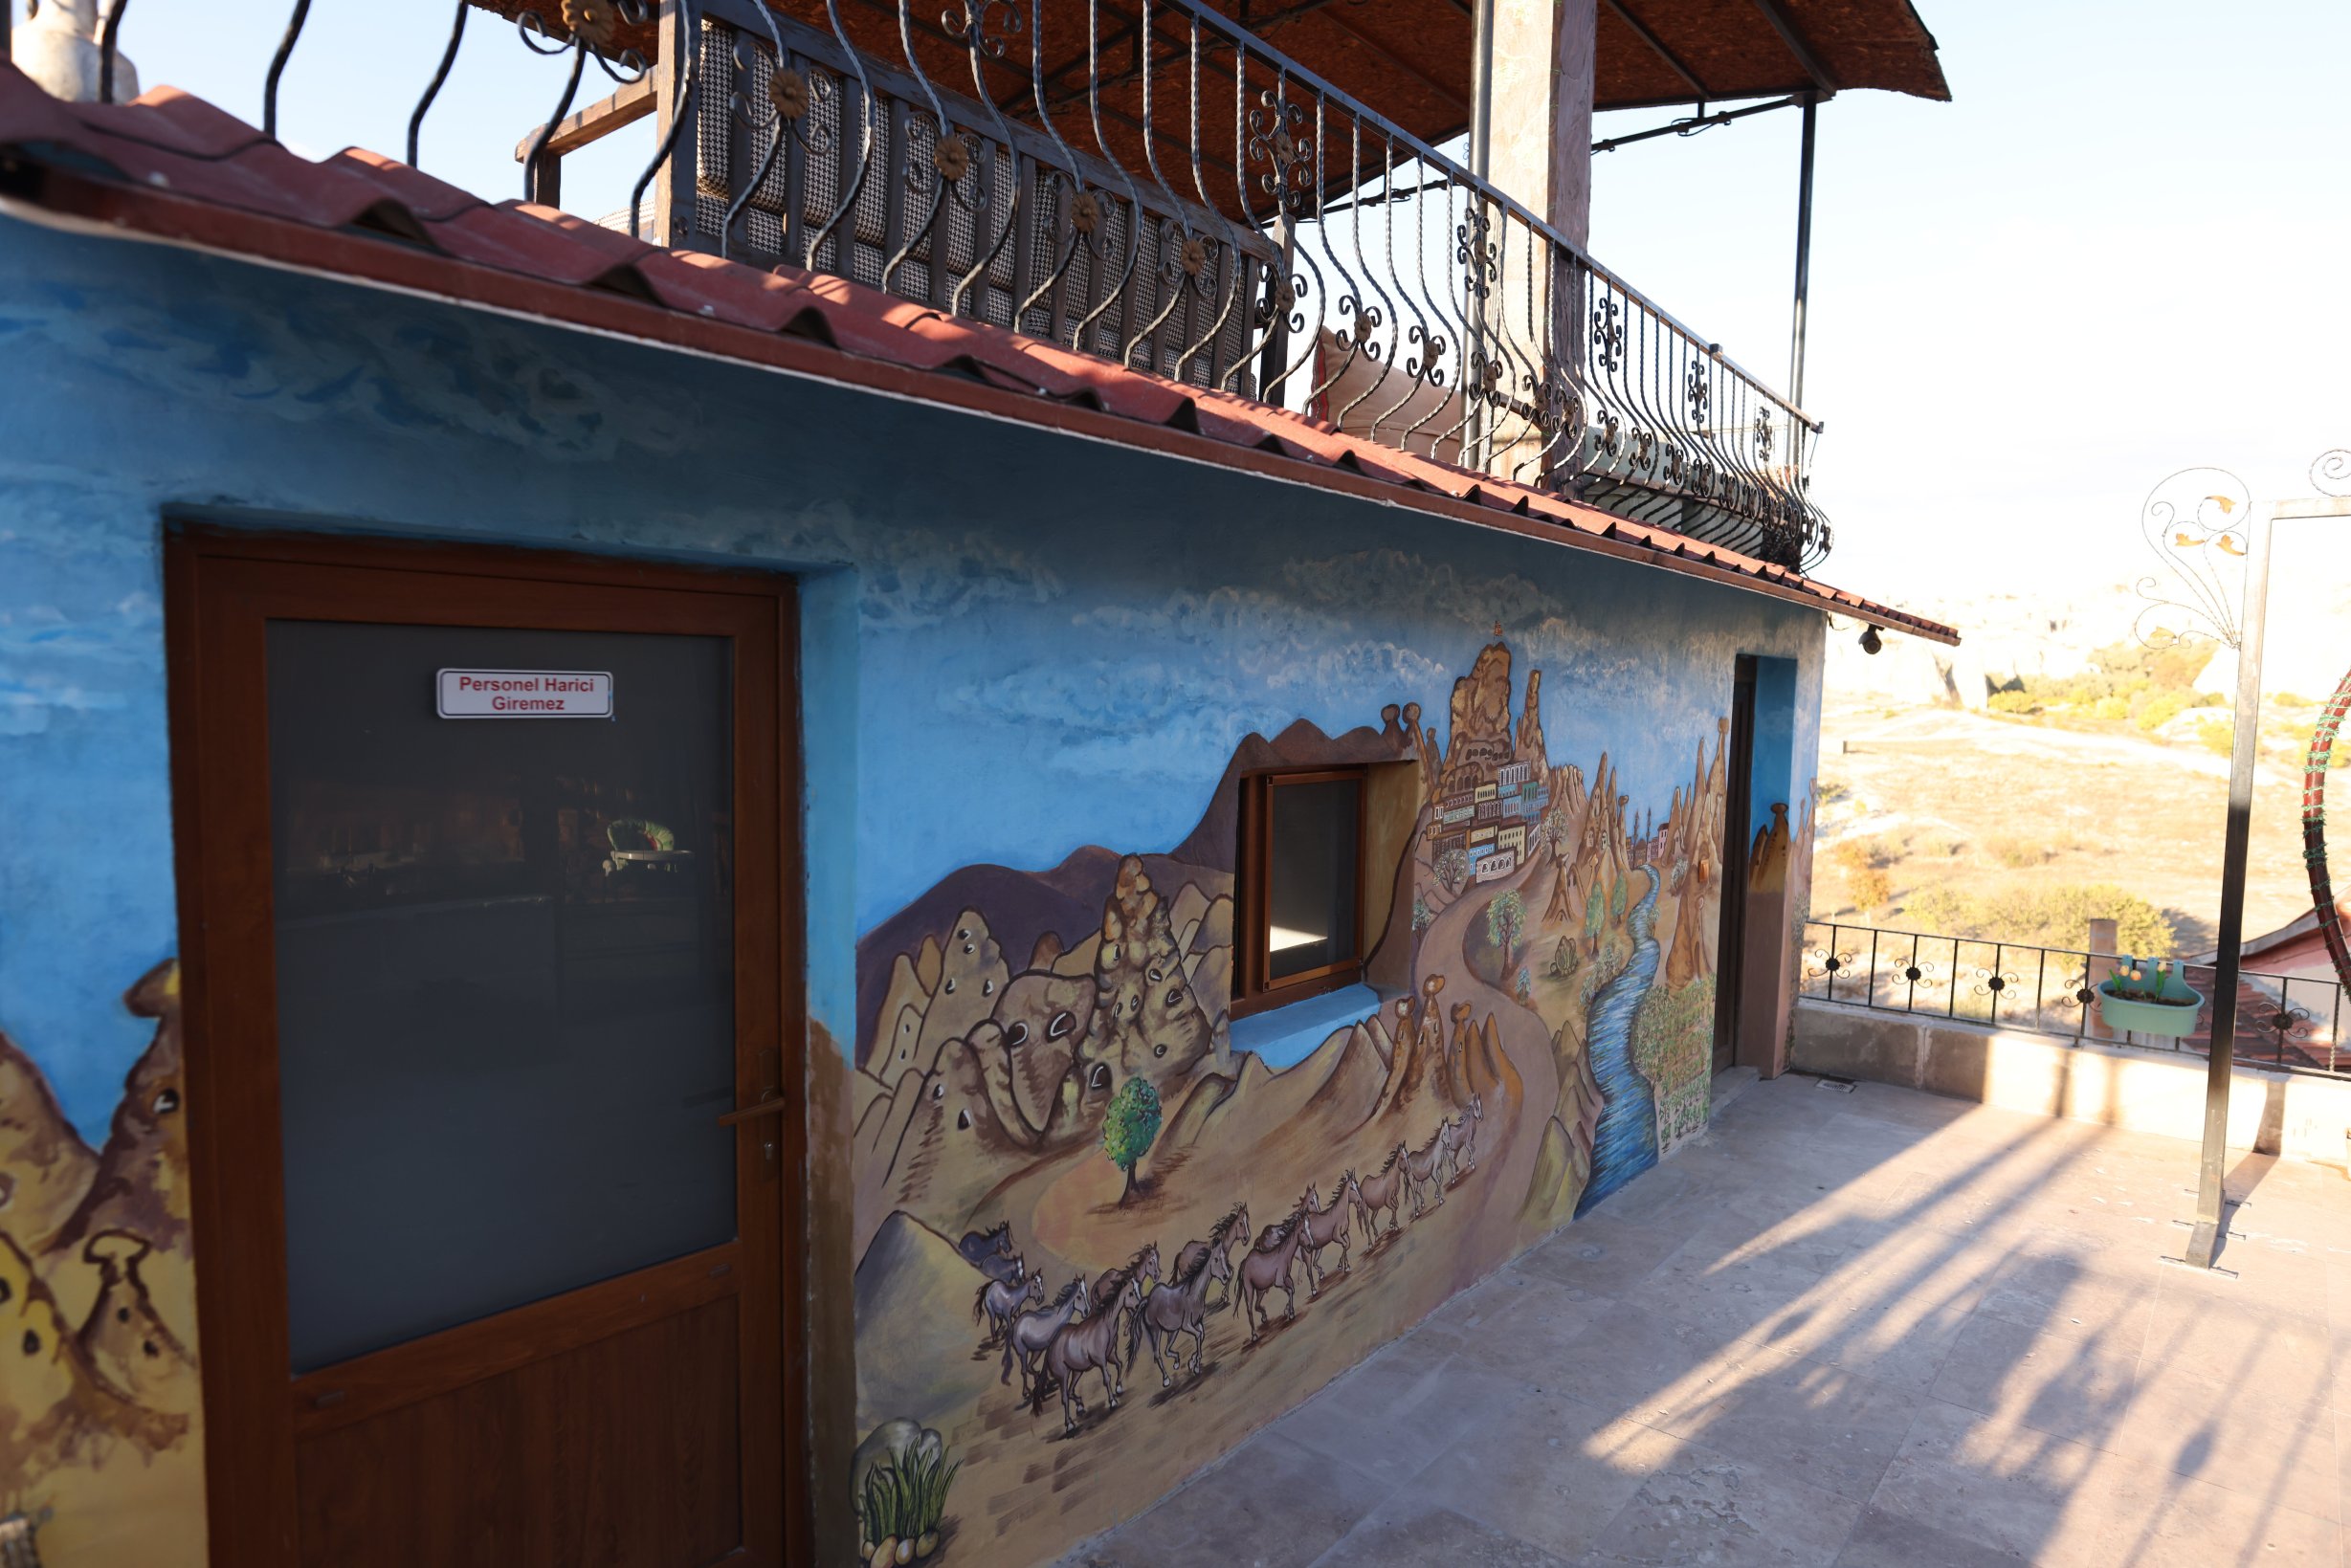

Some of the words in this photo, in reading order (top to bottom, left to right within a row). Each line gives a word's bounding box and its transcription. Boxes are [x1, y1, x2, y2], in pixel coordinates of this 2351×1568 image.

[459, 676, 539, 692] Personel
[544, 678, 594, 692] Harici
[492, 696, 565, 711] Giremez
